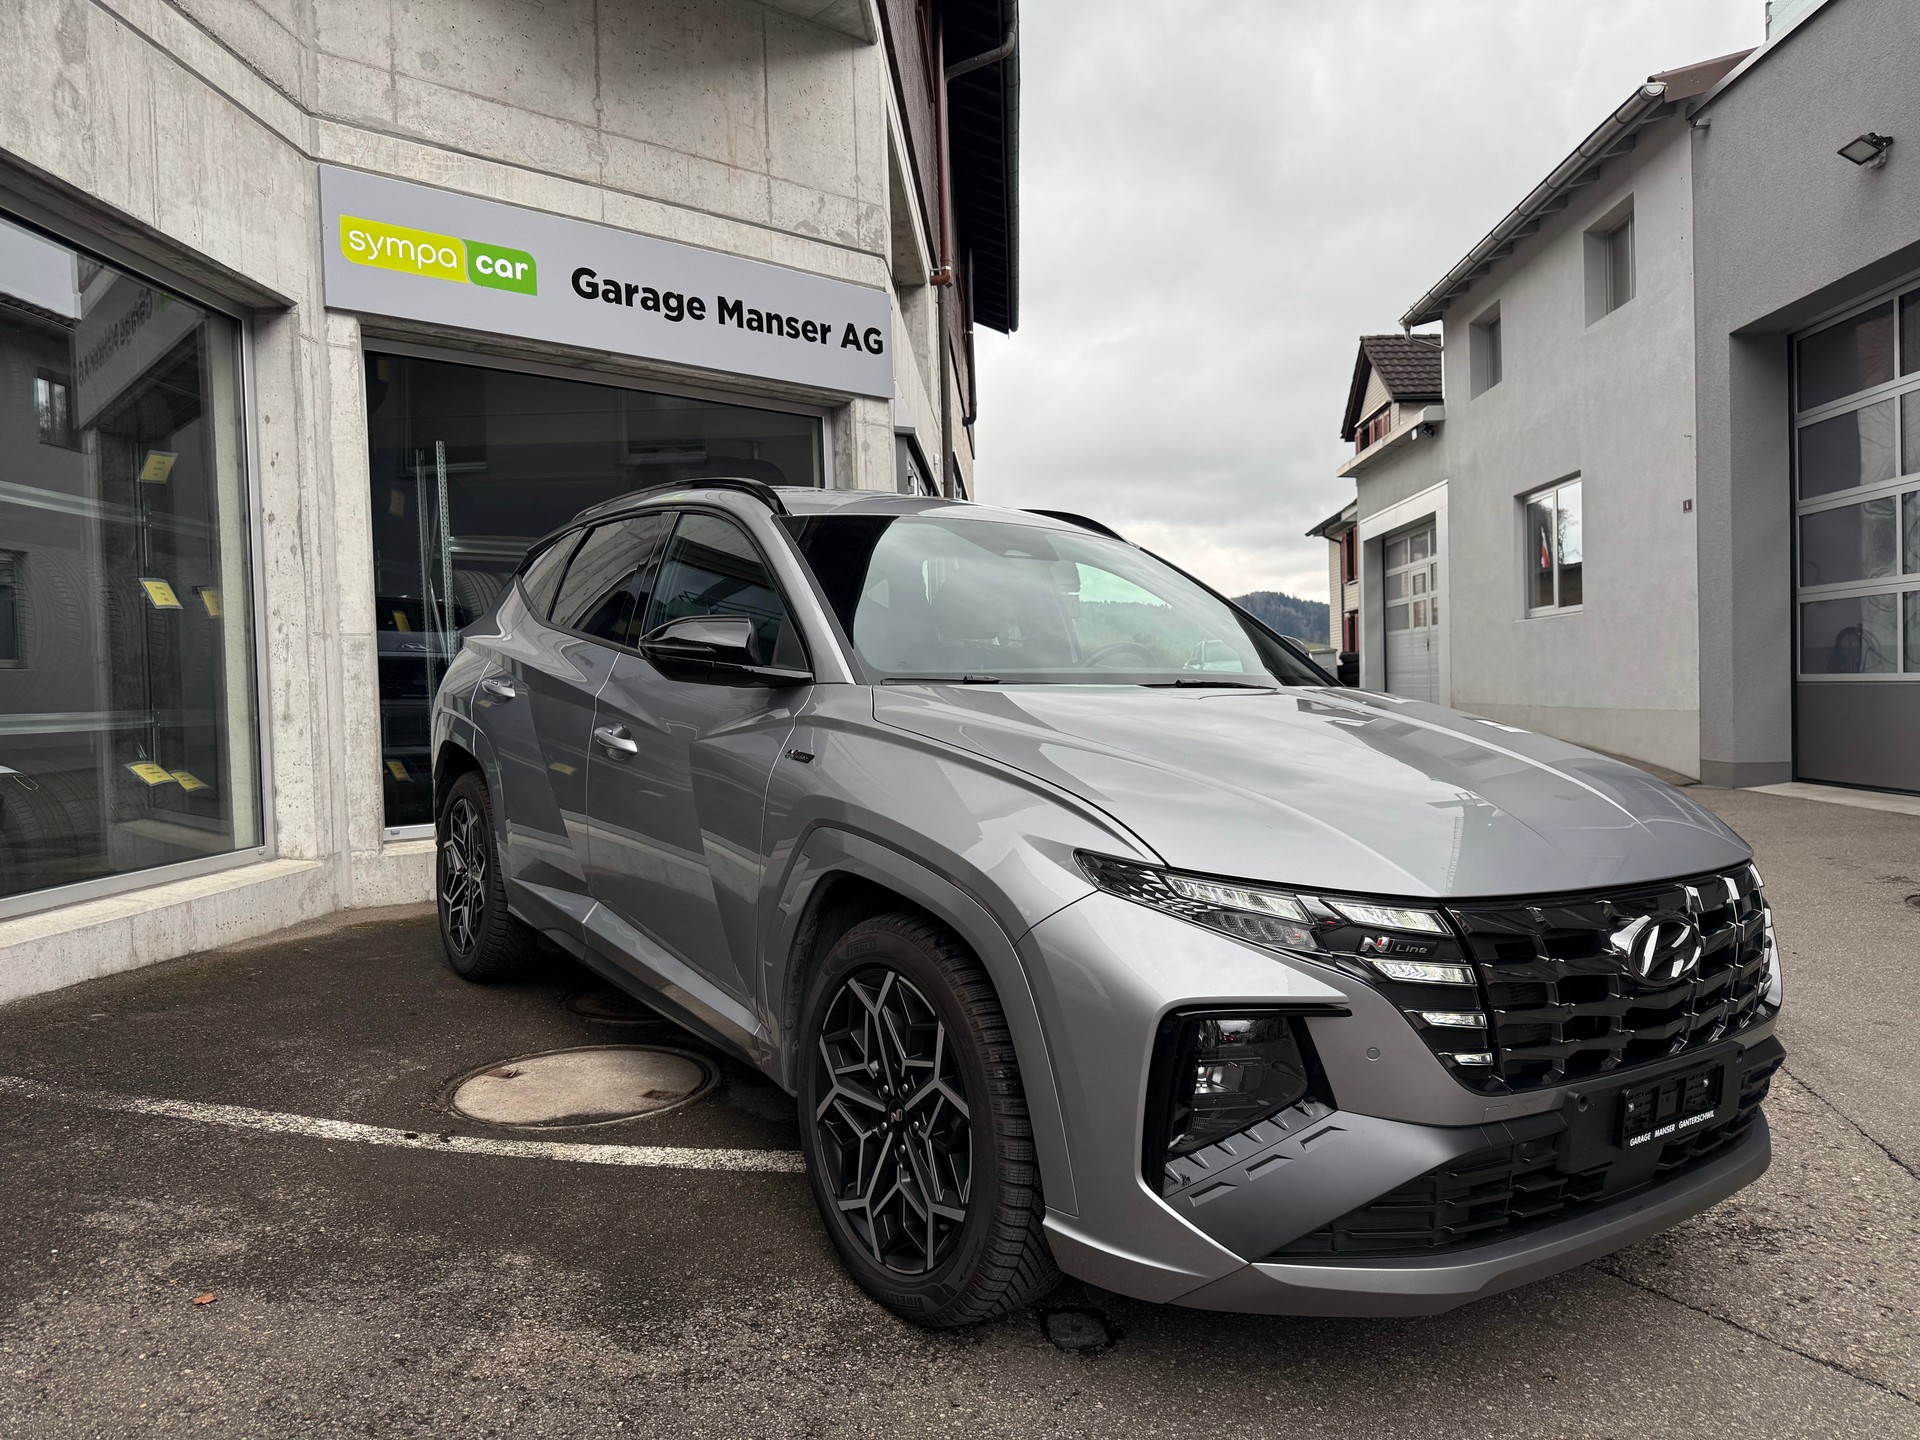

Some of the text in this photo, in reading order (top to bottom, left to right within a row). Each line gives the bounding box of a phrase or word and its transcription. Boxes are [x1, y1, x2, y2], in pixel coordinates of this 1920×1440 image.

[348, 229, 529, 281] sympa car
[570, 266, 885, 355] Garage Manser AG
[1629, 1110, 1715, 1147] GARAGE MANSER GANTERSCHWIL
